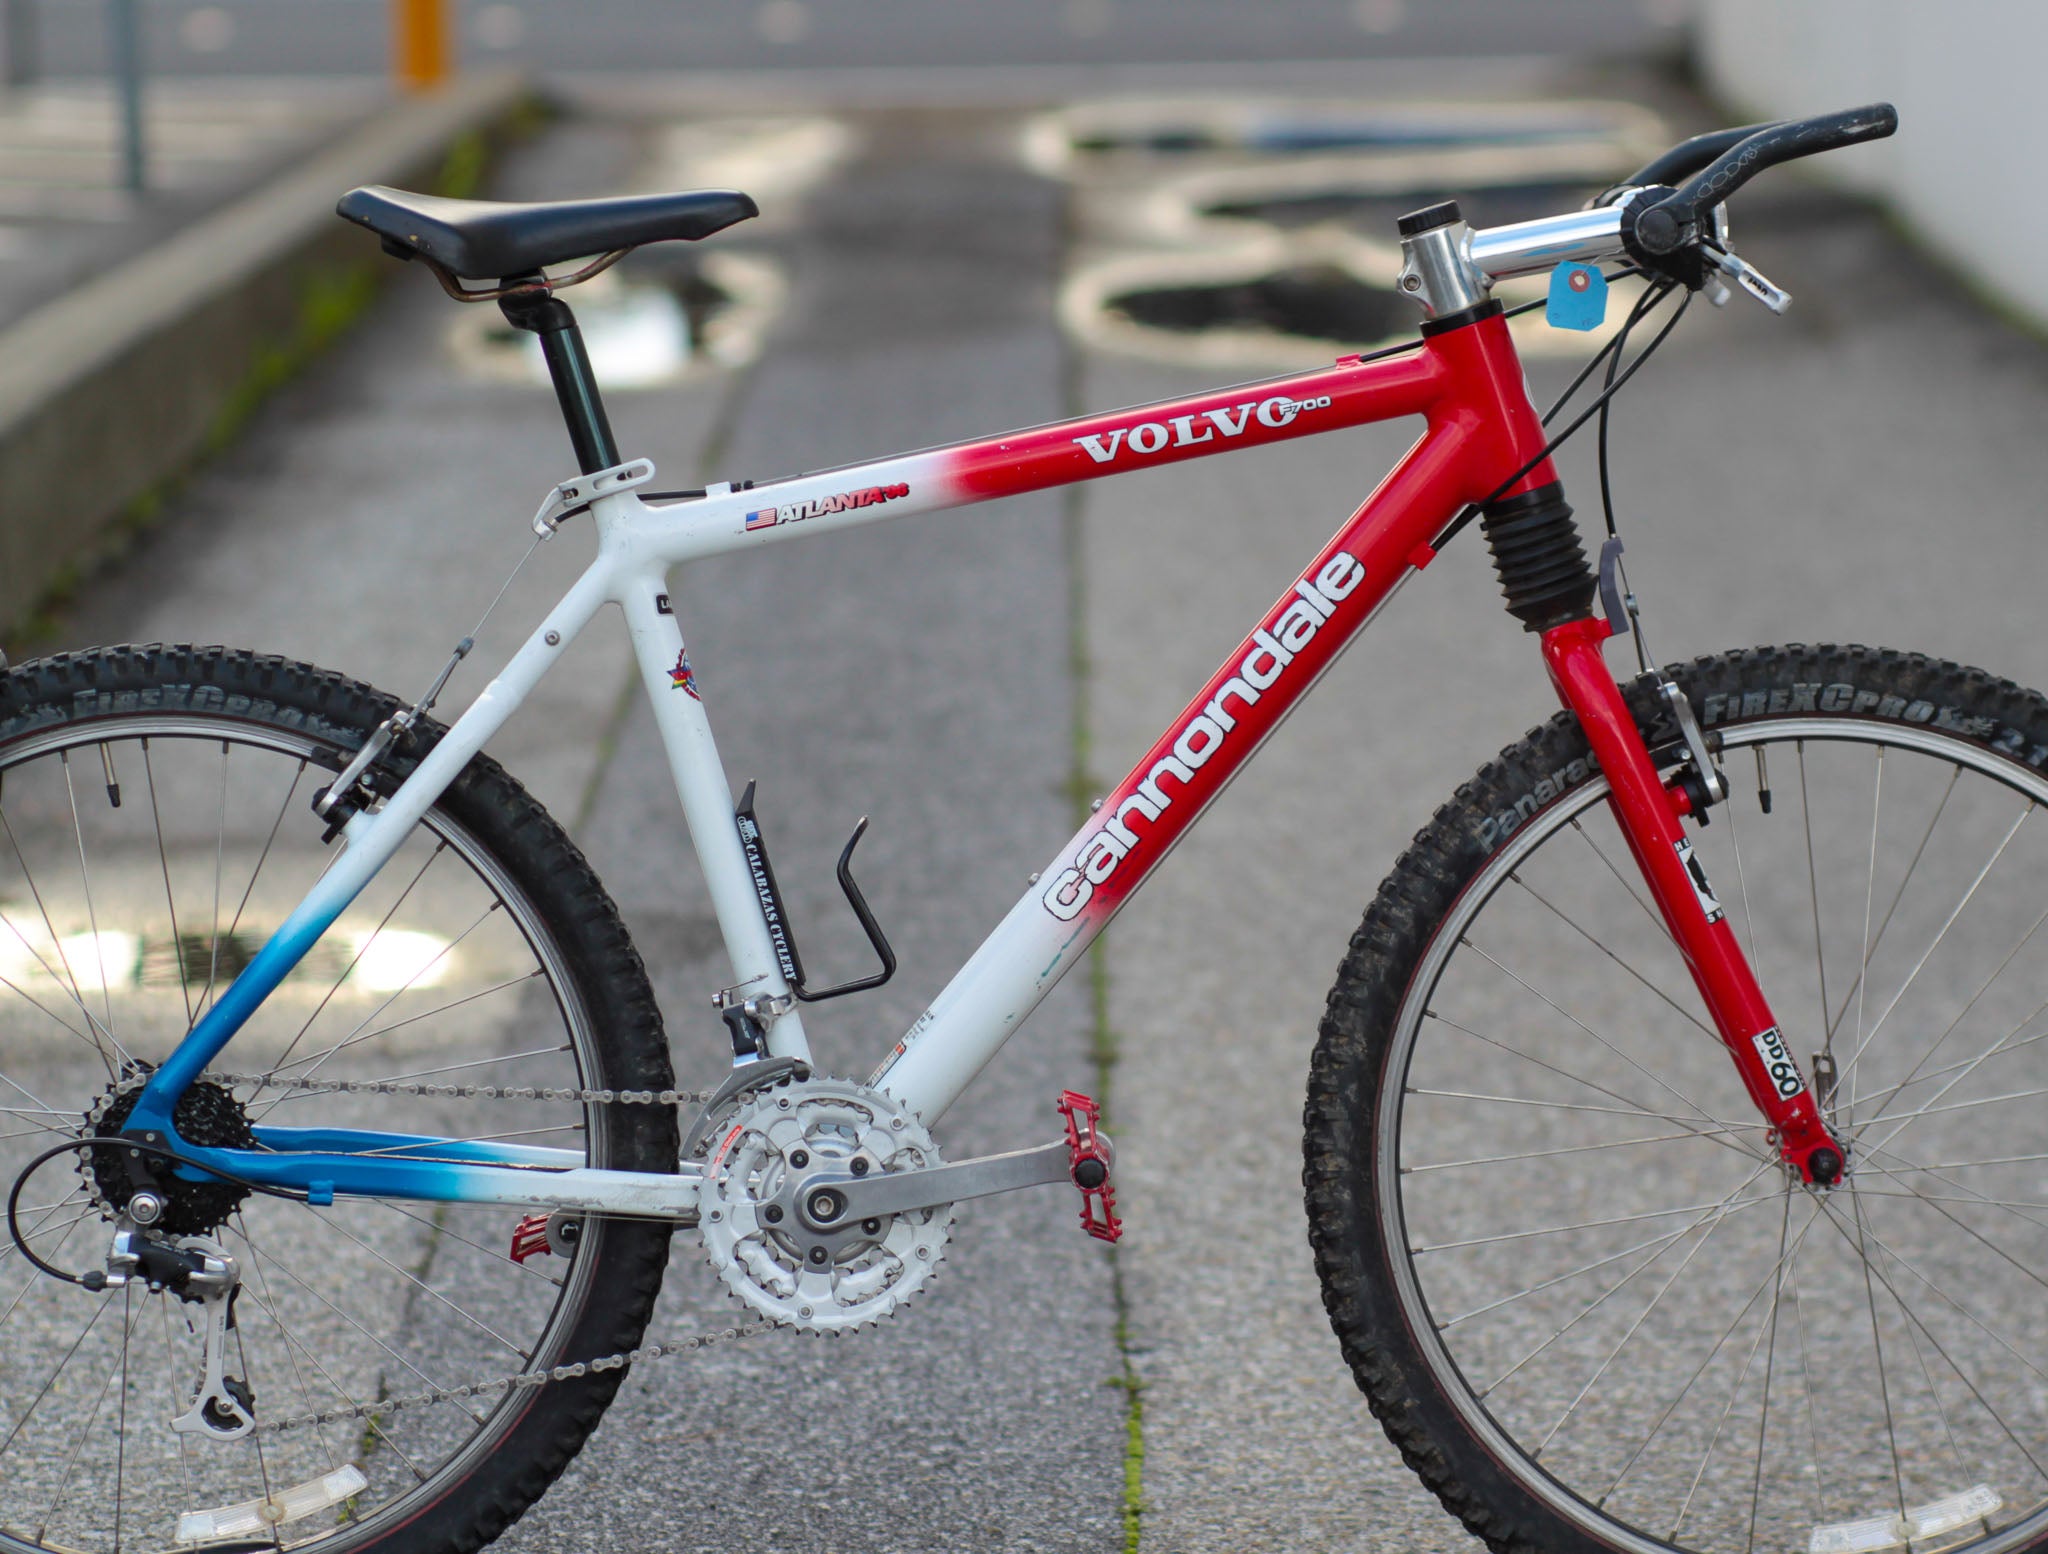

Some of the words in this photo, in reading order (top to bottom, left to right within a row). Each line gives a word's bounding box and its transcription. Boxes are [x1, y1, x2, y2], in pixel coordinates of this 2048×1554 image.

[1072, 396, 1298, 463] VOLVO
[1278, 395, 1331, 417] F700
[776, 486, 887, 525] ATLANTA
[1042, 550, 1366, 922] cannondale
[745, 843, 779, 923] CALABAZAS
[770, 923, 797, 981] CYCLERY
